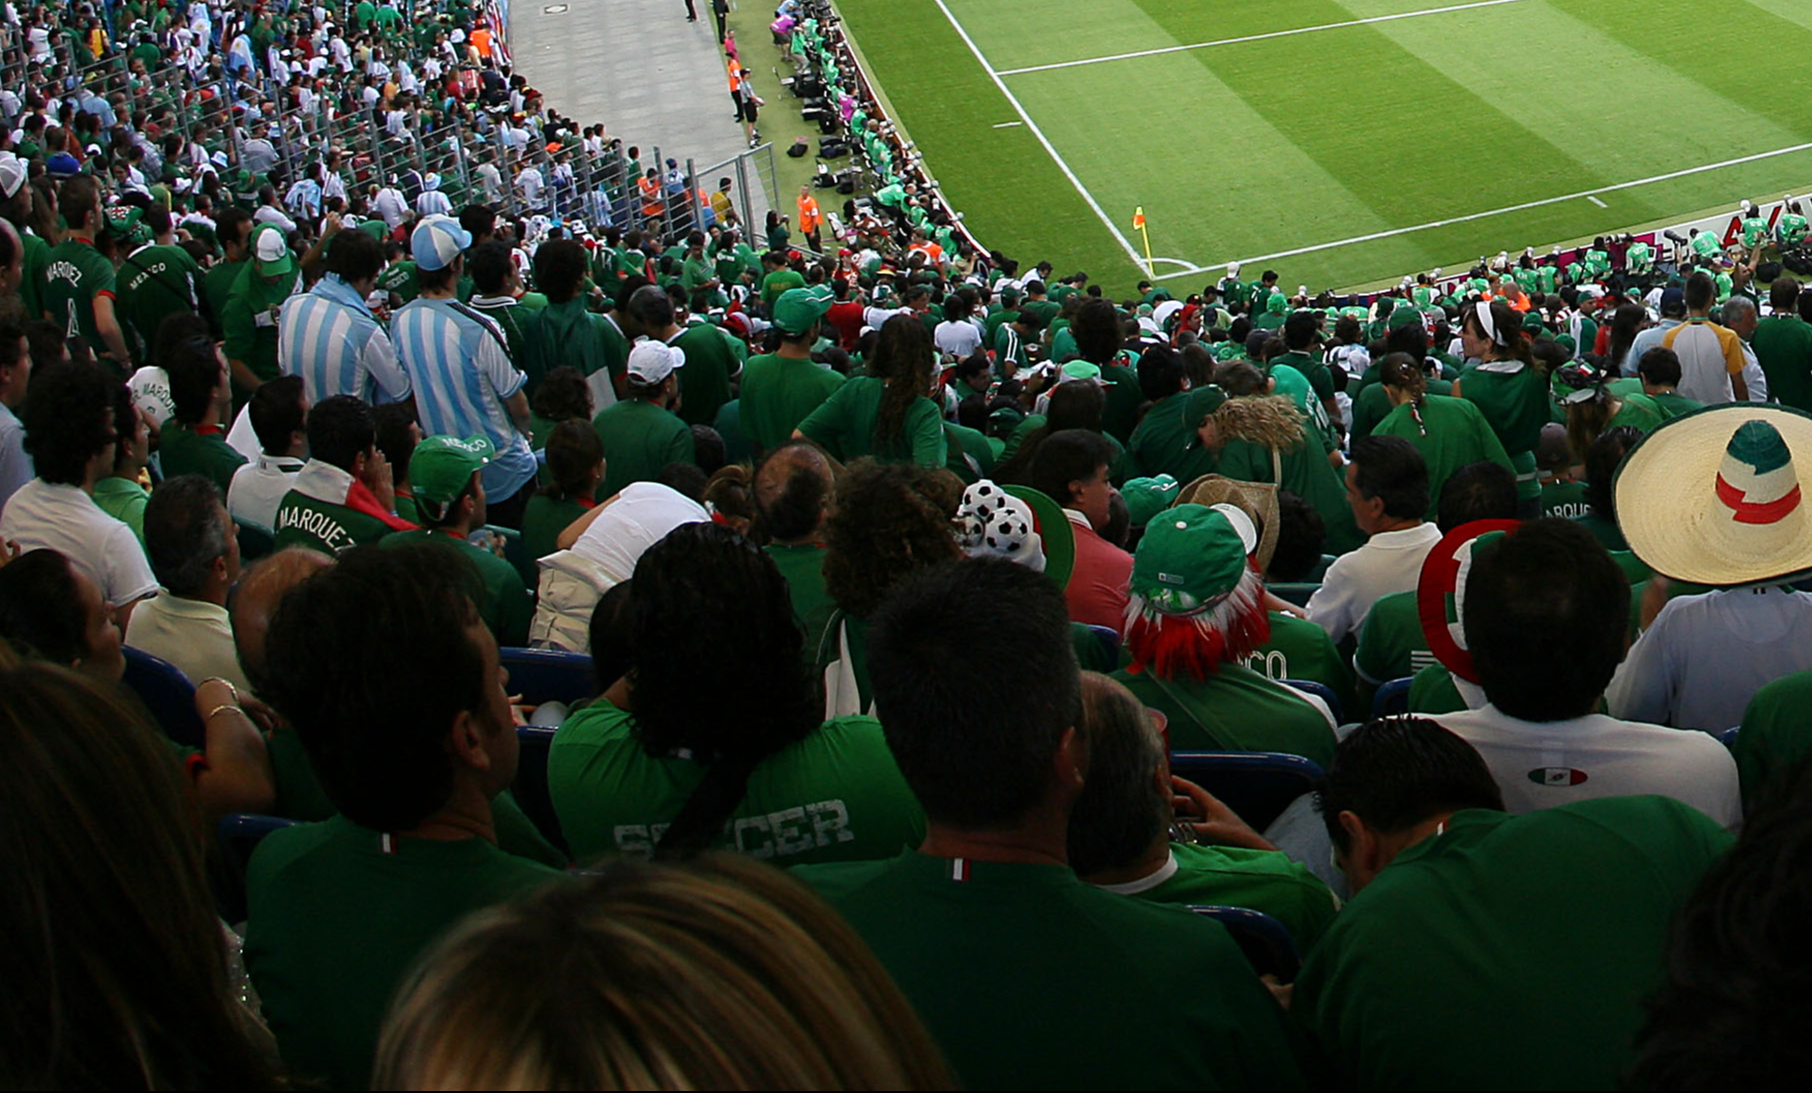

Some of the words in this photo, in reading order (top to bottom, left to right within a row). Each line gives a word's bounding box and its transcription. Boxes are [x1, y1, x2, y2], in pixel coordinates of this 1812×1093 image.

[46, 261, 83, 288] MARQUEZ
[129, 262, 167, 290] MEXCO
[143, 381, 177, 413] MARQUE
[278, 507, 357, 551] MARQUEZ
[1238, 650, 1287, 681] CO
[613, 798, 855, 863] SCER
